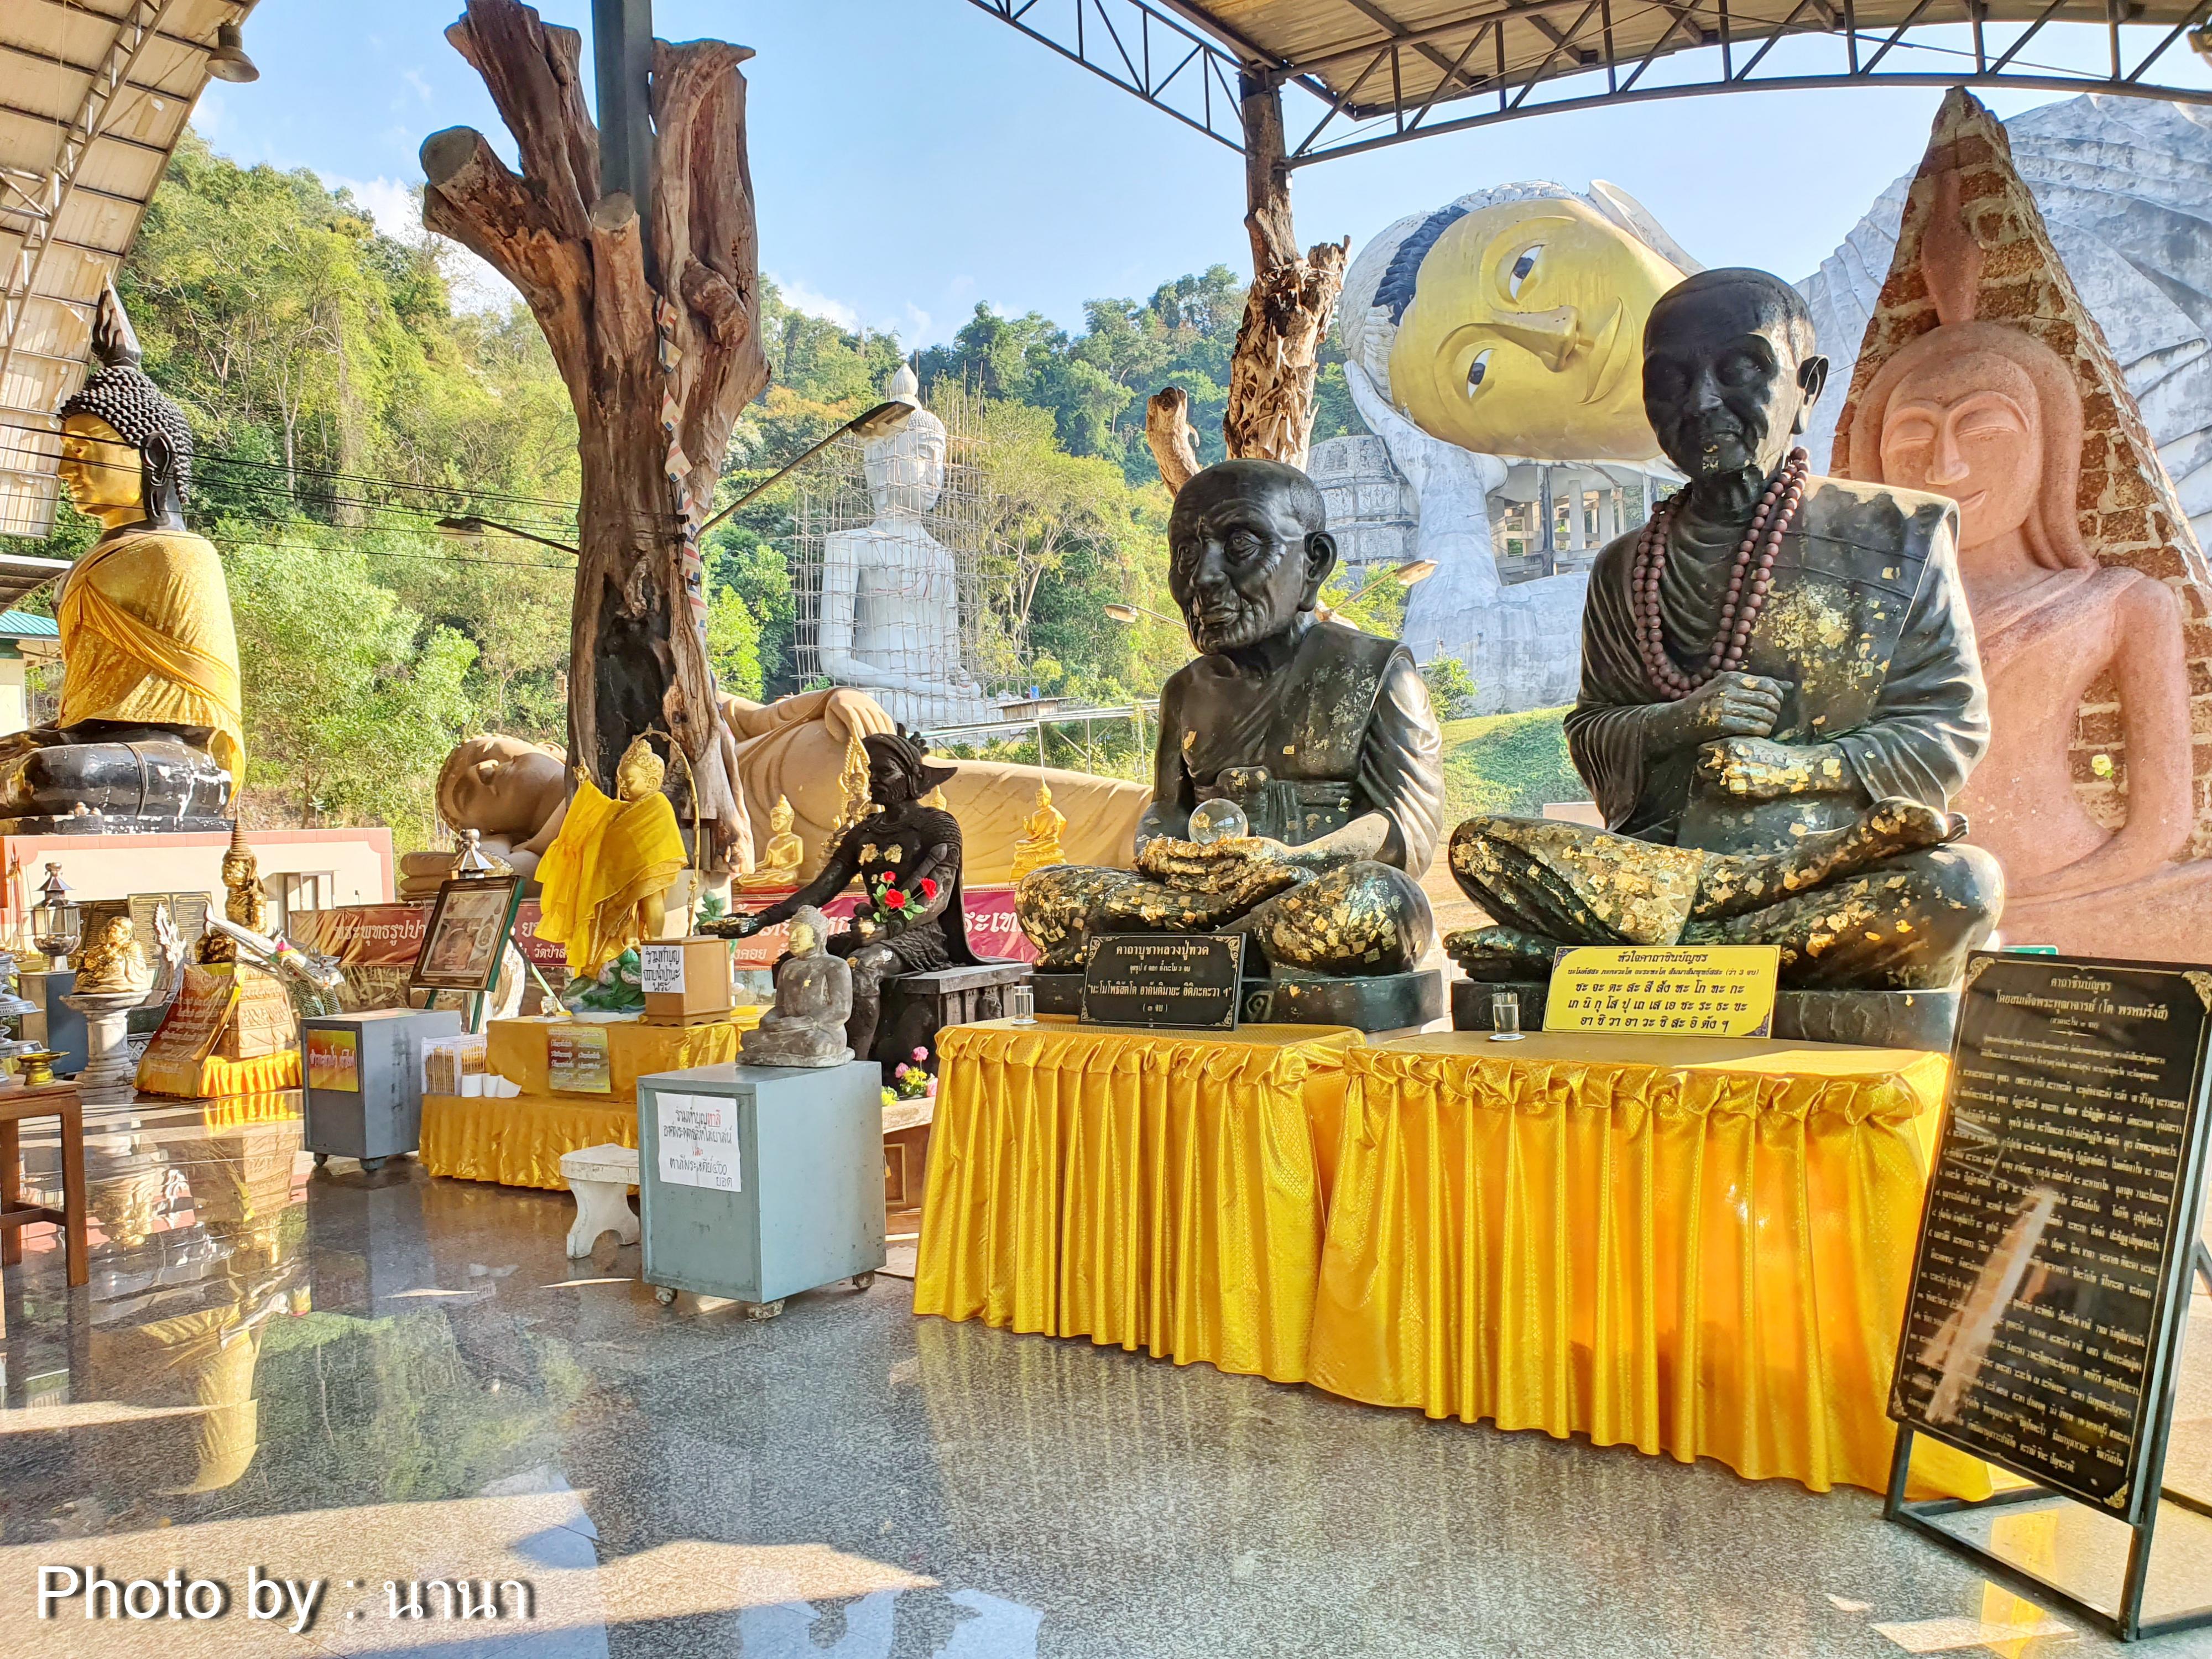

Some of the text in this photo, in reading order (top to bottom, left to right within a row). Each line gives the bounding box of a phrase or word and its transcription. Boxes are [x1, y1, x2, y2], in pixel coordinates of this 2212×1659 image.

[645, 946, 680, 967] ร่วมทำบุญ
[1117, 940, 1209, 960] คาถาบูชาหลวงปู่ทวด
[1618, 950, 1708, 964] หัวใจคาถาชินบัญชร
[653, 981, 671, 992] พระ
[1576, 983, 1589, 992] ชะ
[1593, 983, 1606, 992] จะ
[1626, 982, 1641, 993] สะ
[1656, 980, 1671, 993] สัง
[1675, 984, 1690, 993] หะ
[1694, 979, 1707, 993] โก
[1729, 985, 1745, 994] กะ
[1583, 997, 1593, 1009] นิ
[1594, 1000, 1603, 1013] กุ
[1606, 995, 1619, 1009] โส
[1622, 998, 1631, 1013] ปุ
[1649, 1000, 1662, 1010] เส
[1665, 1001, 1677, 1010] เอ
[1681, 1001, 1694, 1011] ชะ
[1698, 1001, 1712, 1011] ระ
[1716, 1002, 1730, 1011] ธะ
[1580, 1016, 1594, 1025] อา
[1609, 1018, 1621, 1026] วา
[1625, 1018, 1638, 1027] อา
[1642, 1018, 1656, 1027] วะ
[1671, 1018, 1686, 1029] สะ
[1689, 1016, 1699, 1029] อิ
[1700, 1015, 1718, 1029] ตัง
[1721, 1020, 1730, 1033] ฯ
[716, 1176, 733, 1188] ยอด
